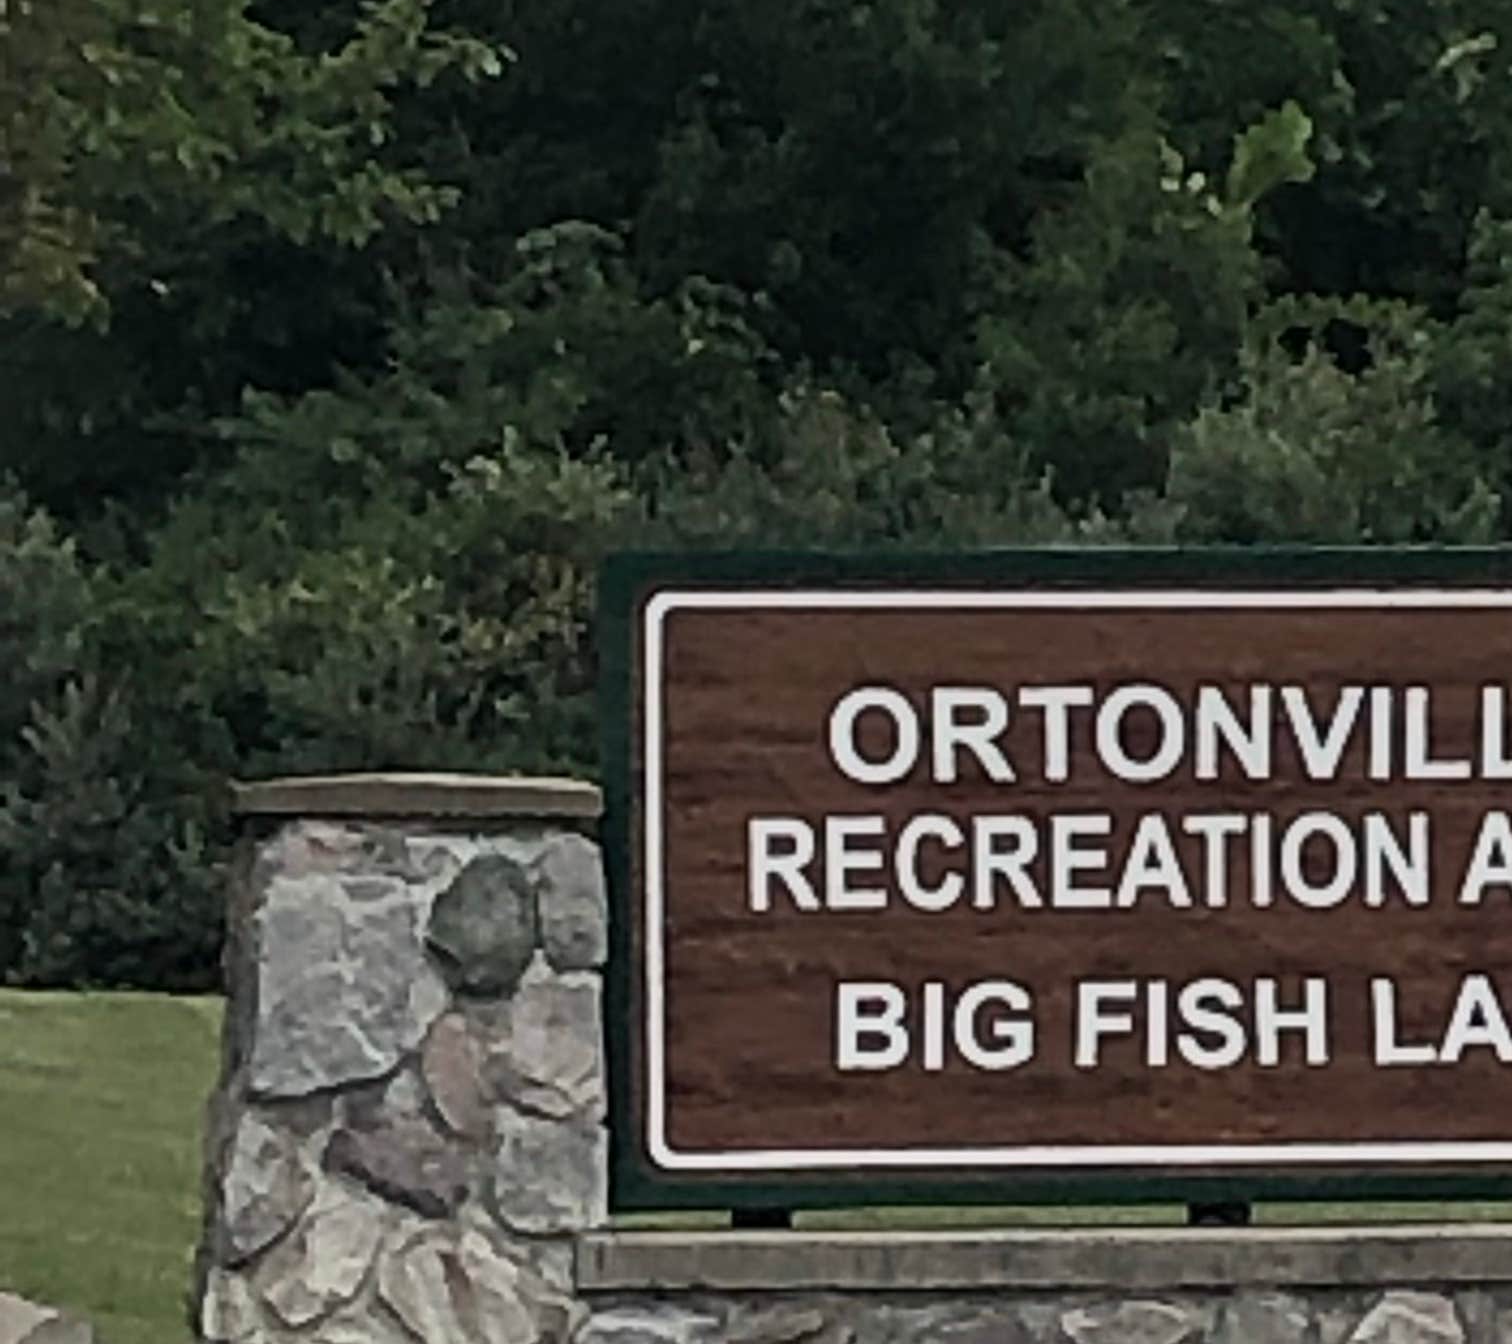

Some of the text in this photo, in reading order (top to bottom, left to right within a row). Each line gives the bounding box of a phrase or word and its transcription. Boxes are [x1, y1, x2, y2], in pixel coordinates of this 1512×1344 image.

[748, 812, 1429, 912] RECREATION
[837, 981, 1034, 1071] BIG
[1075, 978, 1329, 1069] FISH
